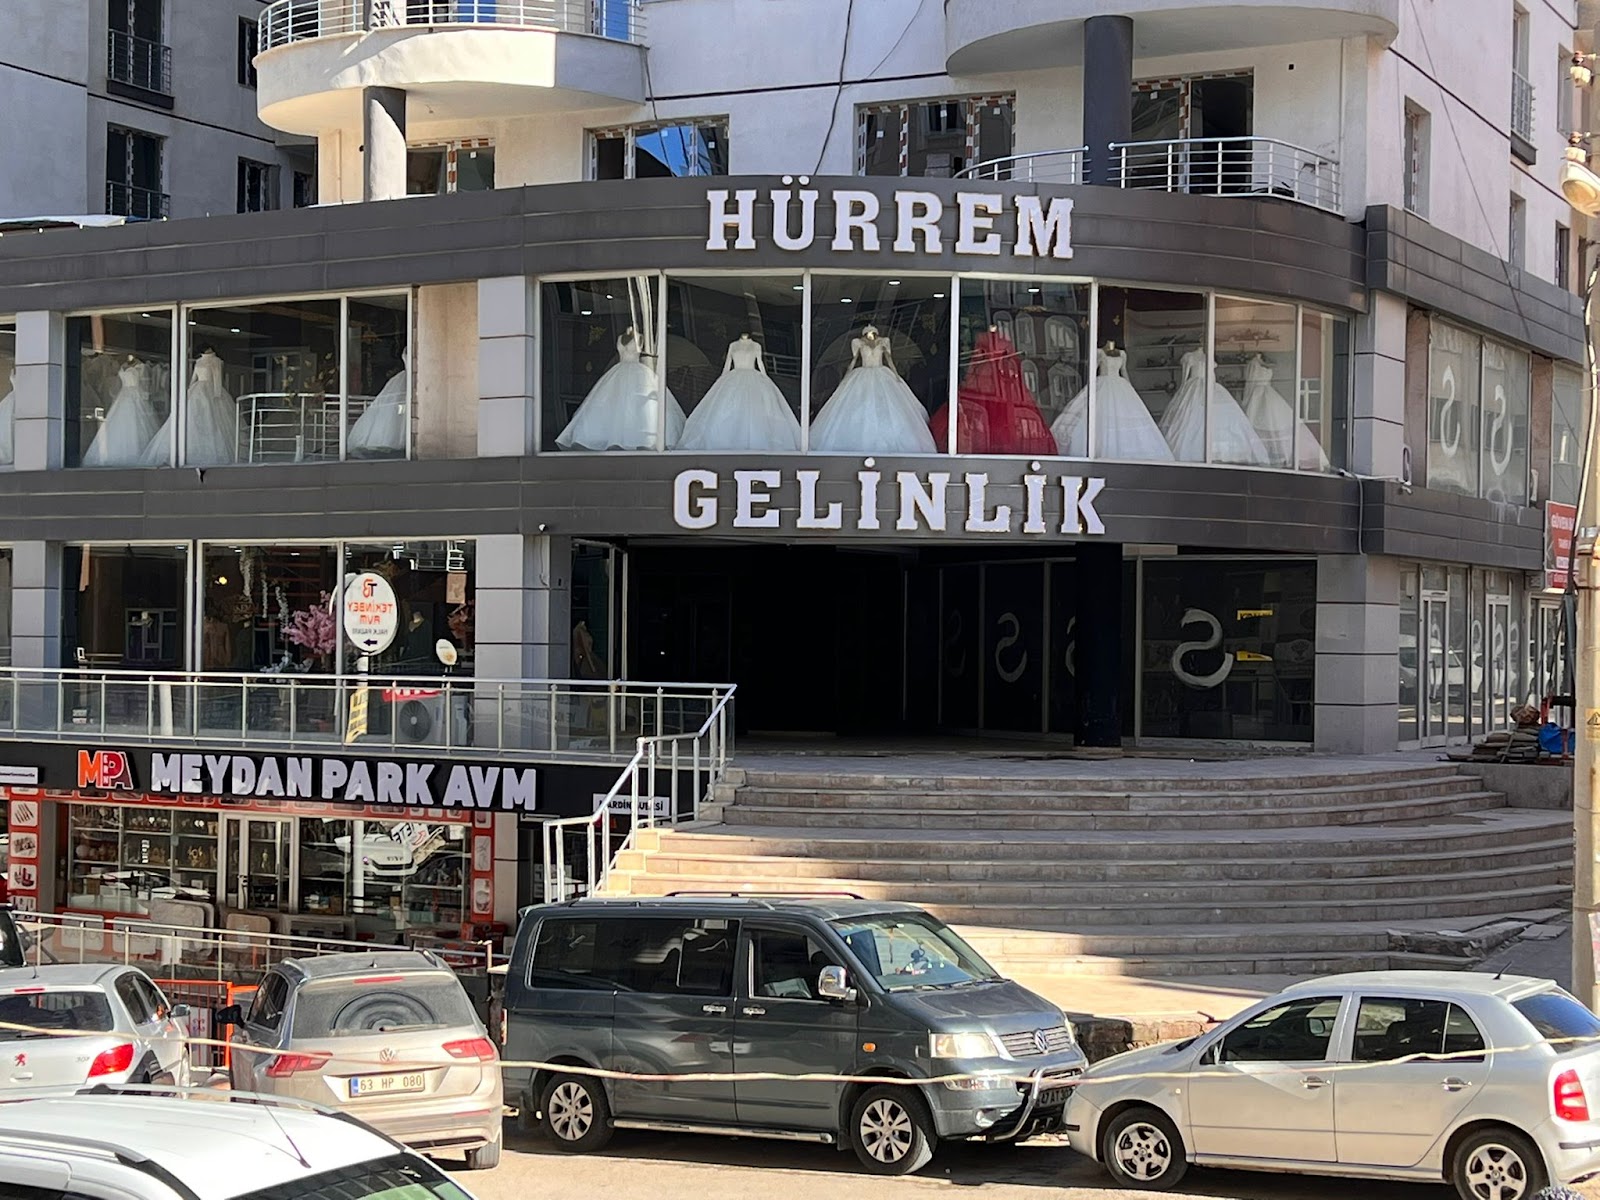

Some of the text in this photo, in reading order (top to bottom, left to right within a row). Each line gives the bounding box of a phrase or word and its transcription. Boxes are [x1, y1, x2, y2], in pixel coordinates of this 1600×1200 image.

[706, 175, 1074, 259] HÜRREM
[674, 457, 1105, 534] GELİNLİK
[151, 752, 537, 811] MEYDAN PARK AVM
[599, 799, 632, 809] ARDİN
[360, 1075, 422, 1091] 63 HP 080
